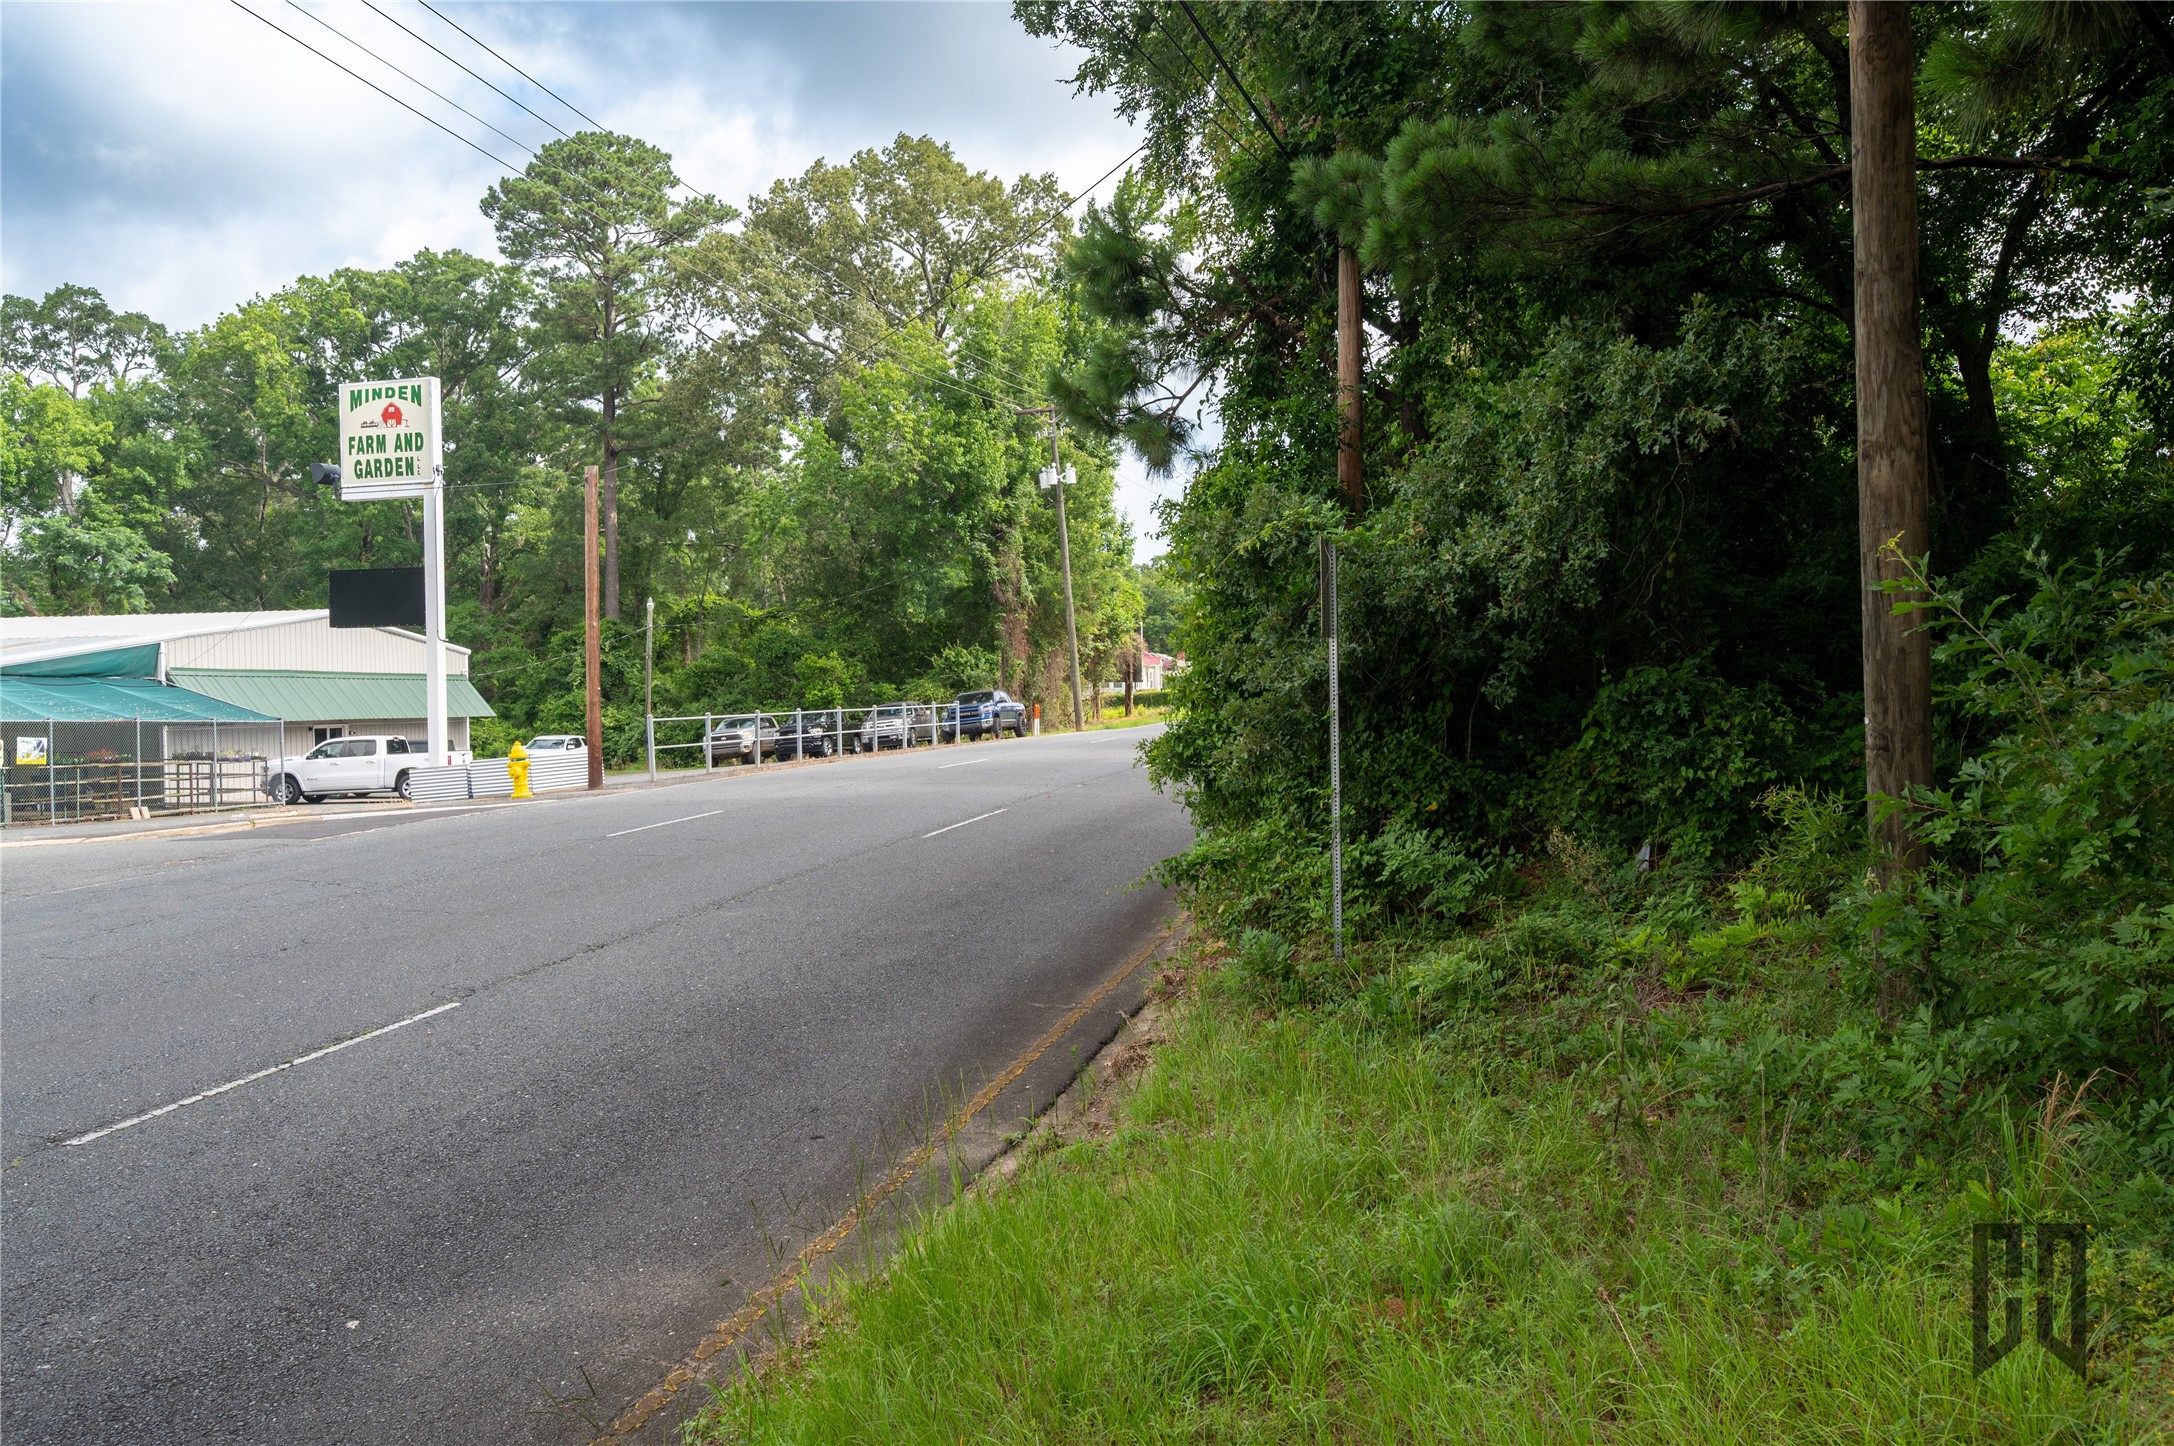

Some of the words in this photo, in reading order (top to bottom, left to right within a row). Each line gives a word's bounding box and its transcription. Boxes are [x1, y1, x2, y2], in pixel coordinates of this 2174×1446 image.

[349, 384, 422, 413] MINDEN
[348, 434, 386, 456] FARM
[394, 432, 424, 453] AND
[354, 456, 414, 480] GARDEN
